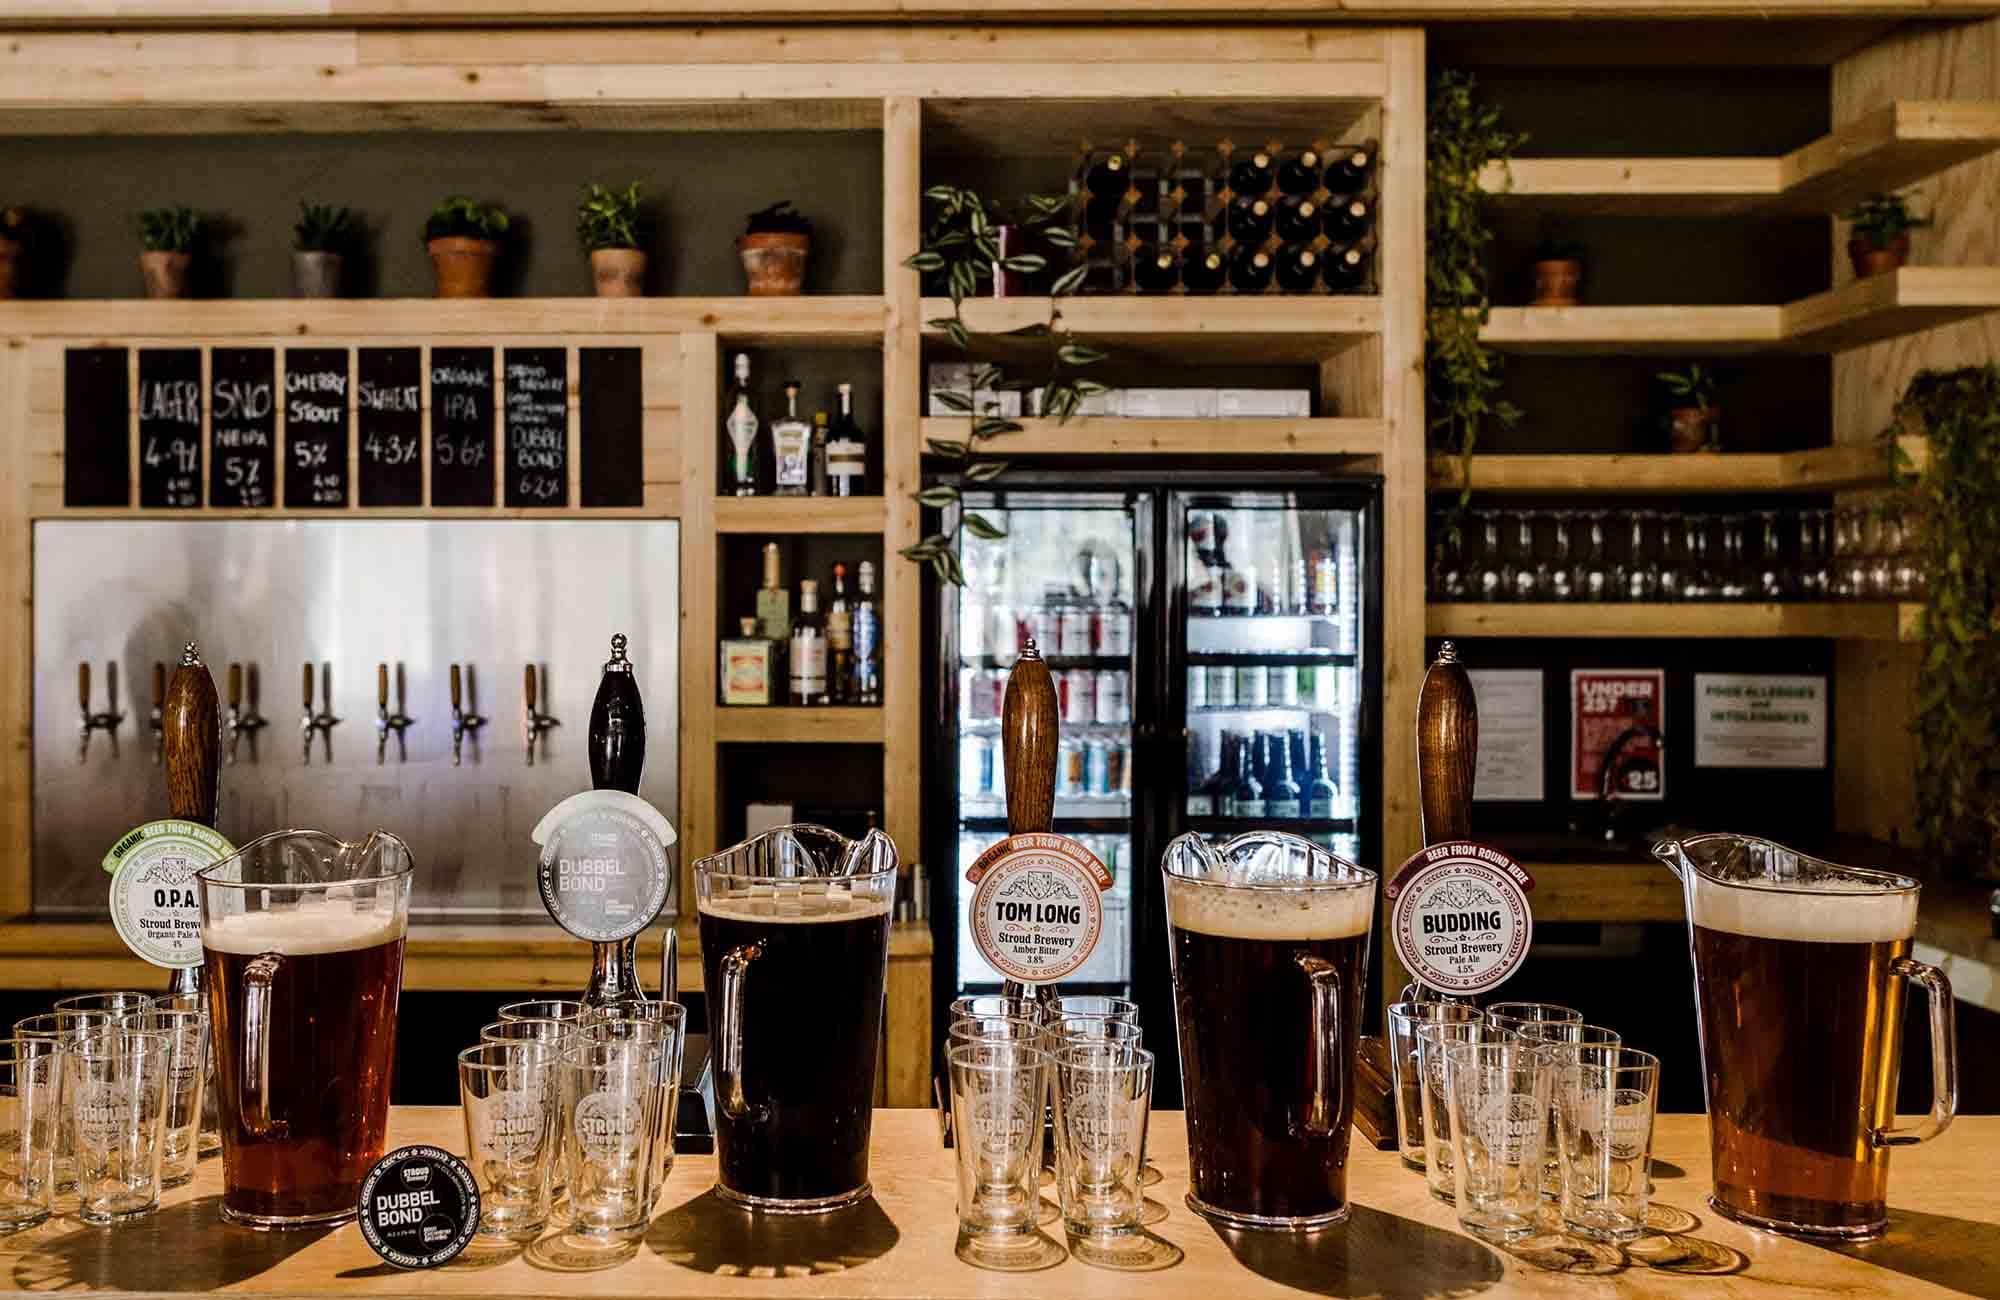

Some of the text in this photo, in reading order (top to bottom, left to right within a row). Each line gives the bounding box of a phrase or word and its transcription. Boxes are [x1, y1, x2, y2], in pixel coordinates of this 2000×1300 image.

[285, 371, 346, 396] CHERRY
[139, 380, 199, 425] LAGER
[213, 379, 272, 420] SNO
[444, 394, 478, 420] IPA
[289, 400, 341, 423] STOUT
[293, 440, 328, 468] 5%
[517, 450, 562, 469] BOND
[225, 456, 260, 486] 5%
[1581, 681, 1653, 697] UNDER
[1627, 770, 1657, 790] 25
[112, 831, 145, 859] ORGANIC
[559, 857, 627, 876] DUBBEL
[977, 837, 1108, 882] ORGANIC BEER FROM ROUND HERE
[1425, 845, 1529, 885] BEER FROM ROUND HERE
[559, 876, 606, 892] BOND
[154, 889, 200, 908] O.P.A.
[996, 902, 1081, 925] TOM LONG
[1423, 911, 1502, 934] BUDDING
[140, 918, 201, 930] Stroud Brew
[147, 930, 175, 940] Organic
[177, 930, 193, 940] Pale
[999, 932, 1075, 948] Stroud Brewery
[1012, 945, 1060, 955] Amber Bitter
[1026, 955, 1044, 964] 3.8%
[1424, 942, 1504, 957] Stroud Brewery
[1449, 955, 1480, 964] Pale Ale
[581, 1117, 635, 1133] STROUD
[403, 1167, 430, 1177] STROUD
[376, 1190, 441, 1211] DUBBEL
[378, 1207, 423, 1227] BOND
